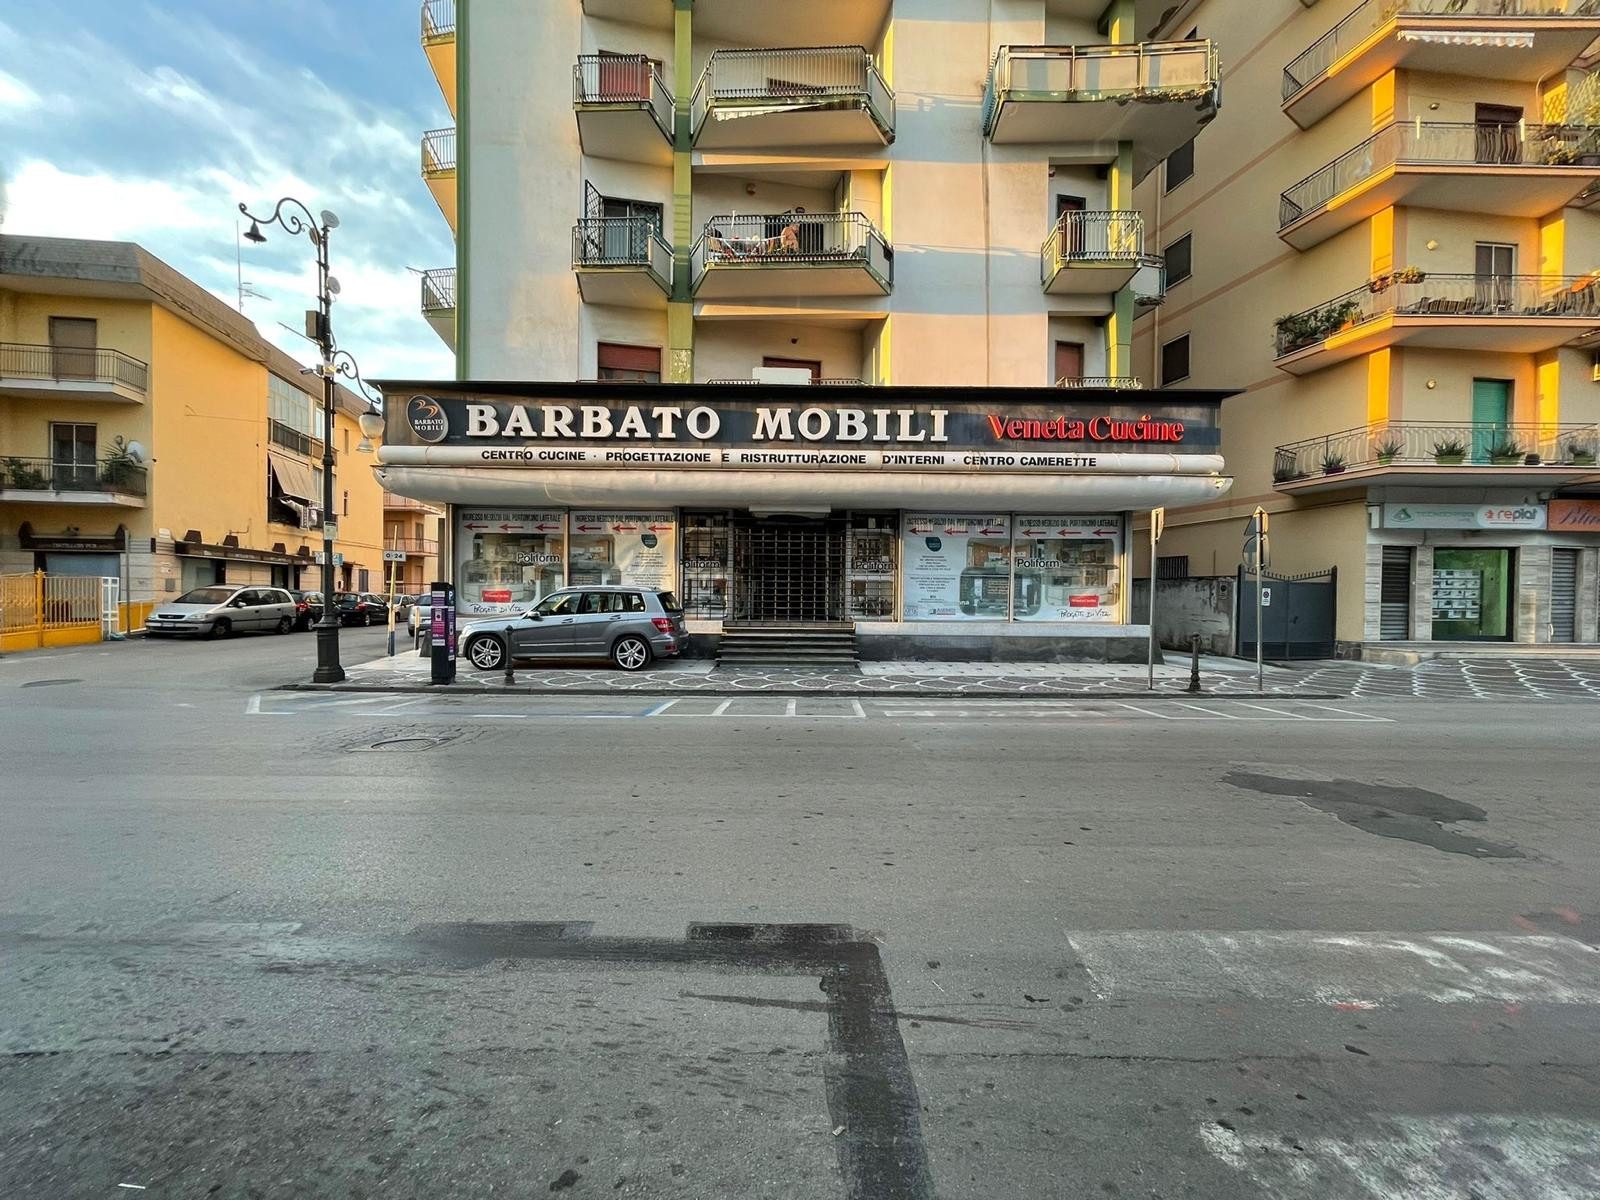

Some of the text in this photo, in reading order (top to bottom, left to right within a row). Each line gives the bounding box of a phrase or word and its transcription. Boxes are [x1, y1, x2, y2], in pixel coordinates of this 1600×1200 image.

[465, 404, 948, 442] BARBATO MOBILI
[987, 414, 1185, 442] Veneta Cucine
[481, 450, 1097, 467] CENTRO CUCINE PROGETTAZIONE E RISTRUTTURAZIONE D'INTERNI CENTRO CAMERETTE
[517, 552, 560, 563] Poliform
[1017, 558, 1060, 569] Poliform
